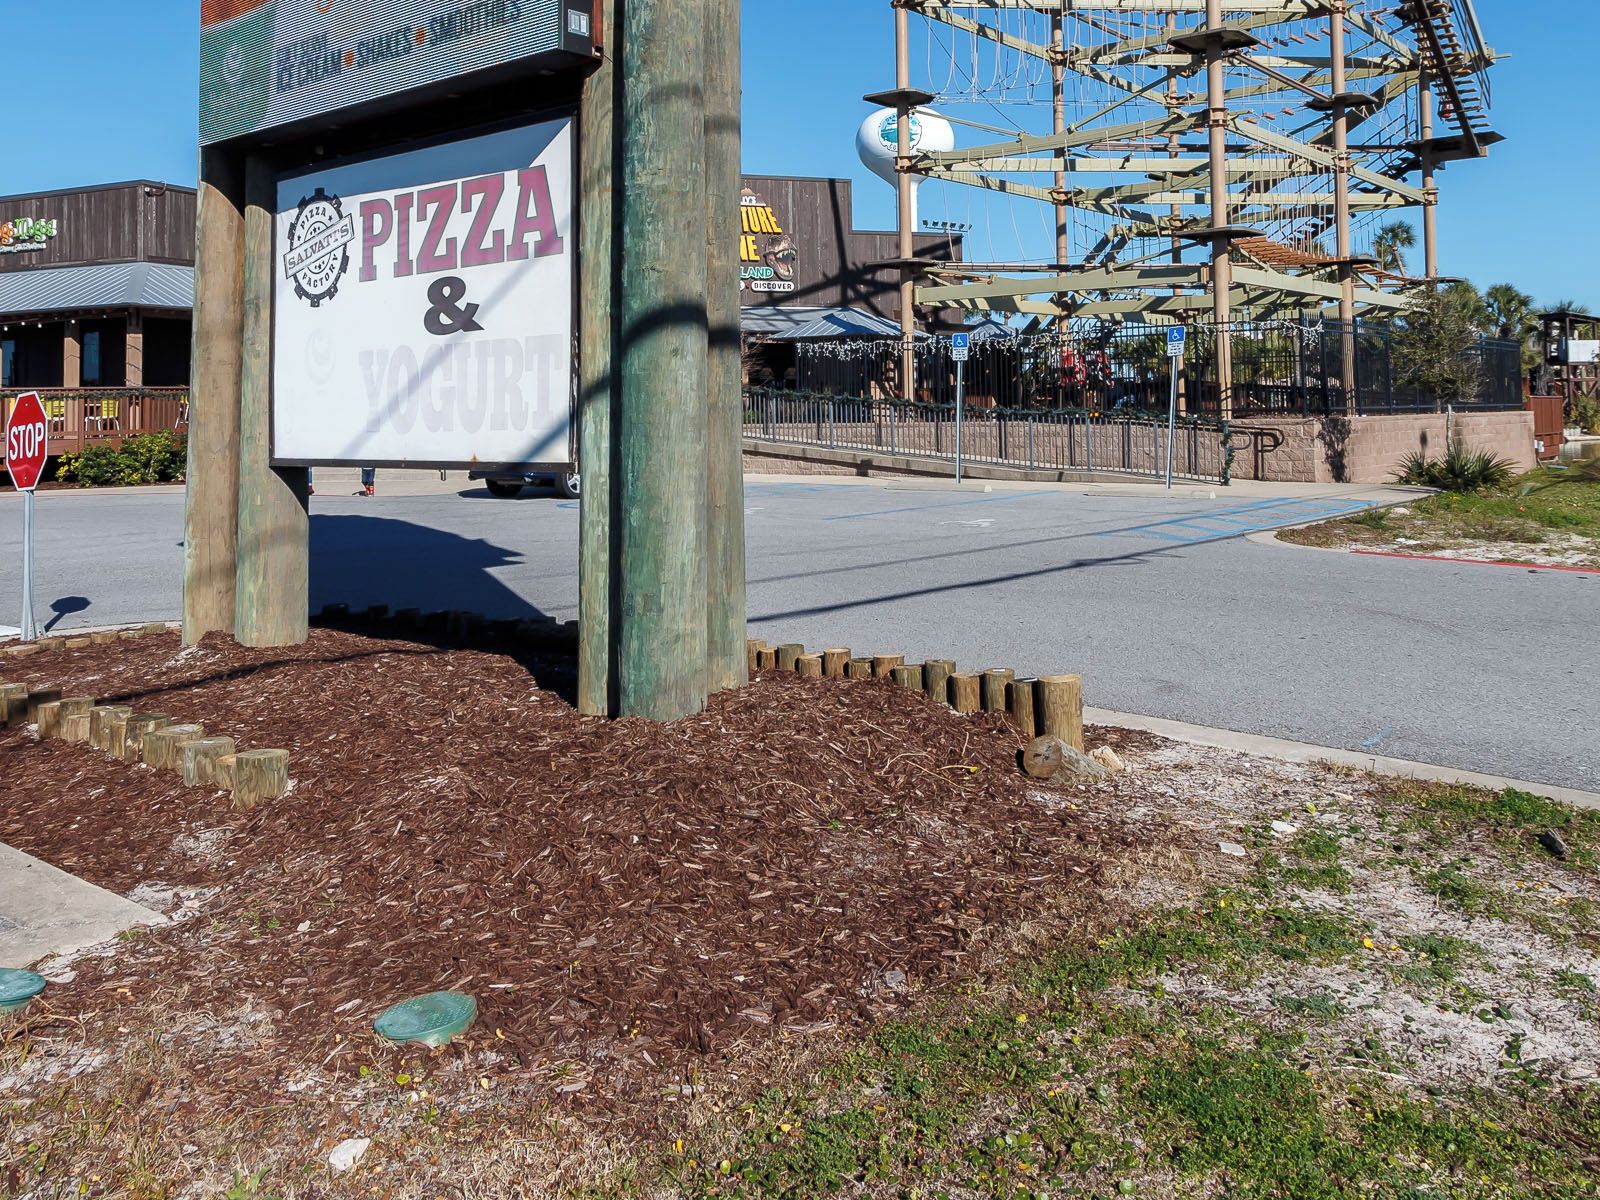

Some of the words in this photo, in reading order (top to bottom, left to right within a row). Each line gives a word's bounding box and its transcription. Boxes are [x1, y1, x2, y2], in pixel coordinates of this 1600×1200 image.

[356, 25, 413, 69] SHAKES
[300, 206, 327, 230] PIZZA
[359, 164, 564, 283] PIZZA
[302, 253, 339, 289] FACTORY
[754, 282, 792, 291] DISCOVER
[423, 276, 485, 336] &
[358, 333, 564, 435] YOGURT
[9, 421, 45, 461] STOP
